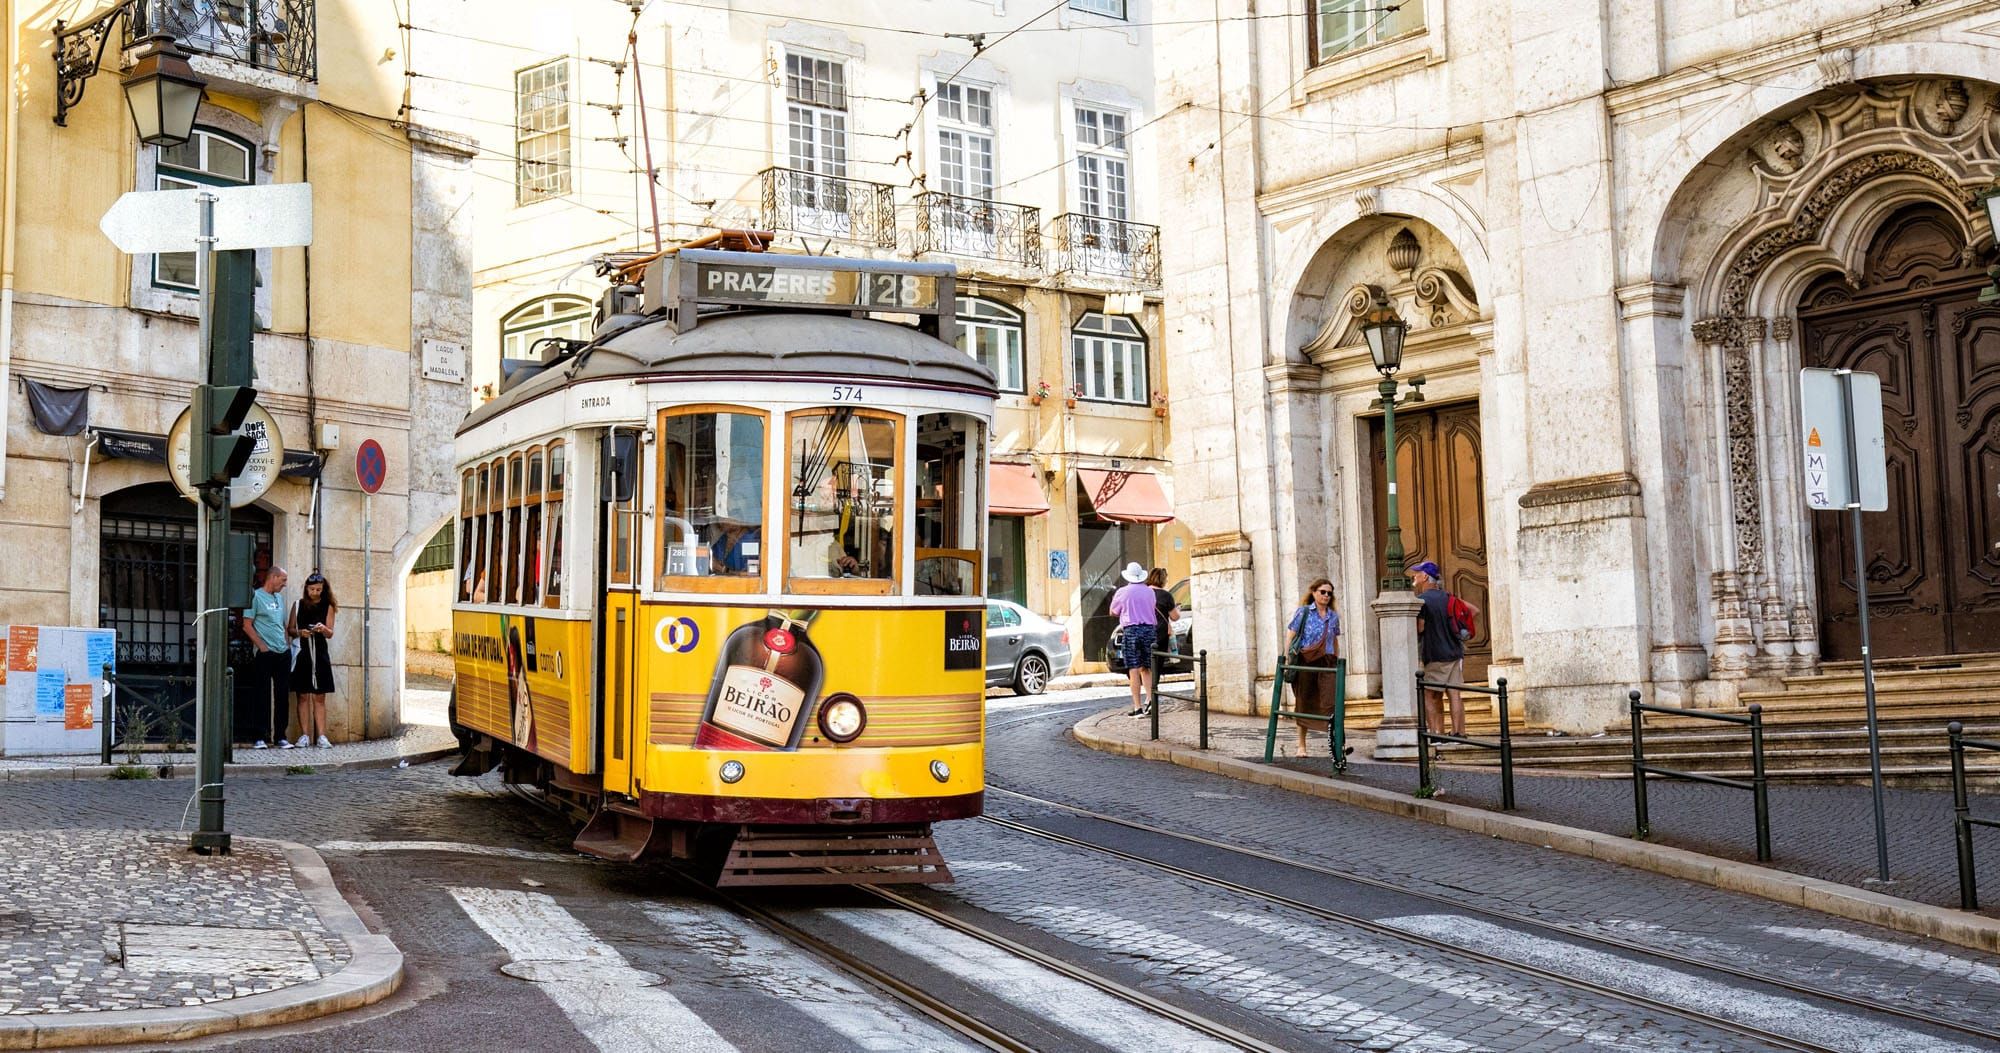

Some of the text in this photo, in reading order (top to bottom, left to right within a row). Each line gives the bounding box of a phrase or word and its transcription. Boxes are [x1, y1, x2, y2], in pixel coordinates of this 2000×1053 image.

[707, 270, 922, 304] PRAZERES 28
[435, 345, 453, 353] LARGO
[441, 356, 448, 364] DA
[430, 366, 458, 376] MADALENA
[832, 386, 863, 402] 574
[581, 396, 611, 409] ENTRADA
[950, 637, 979, 651] BEIRÃO
[724, 685, 791, 723] BEIRÃO
